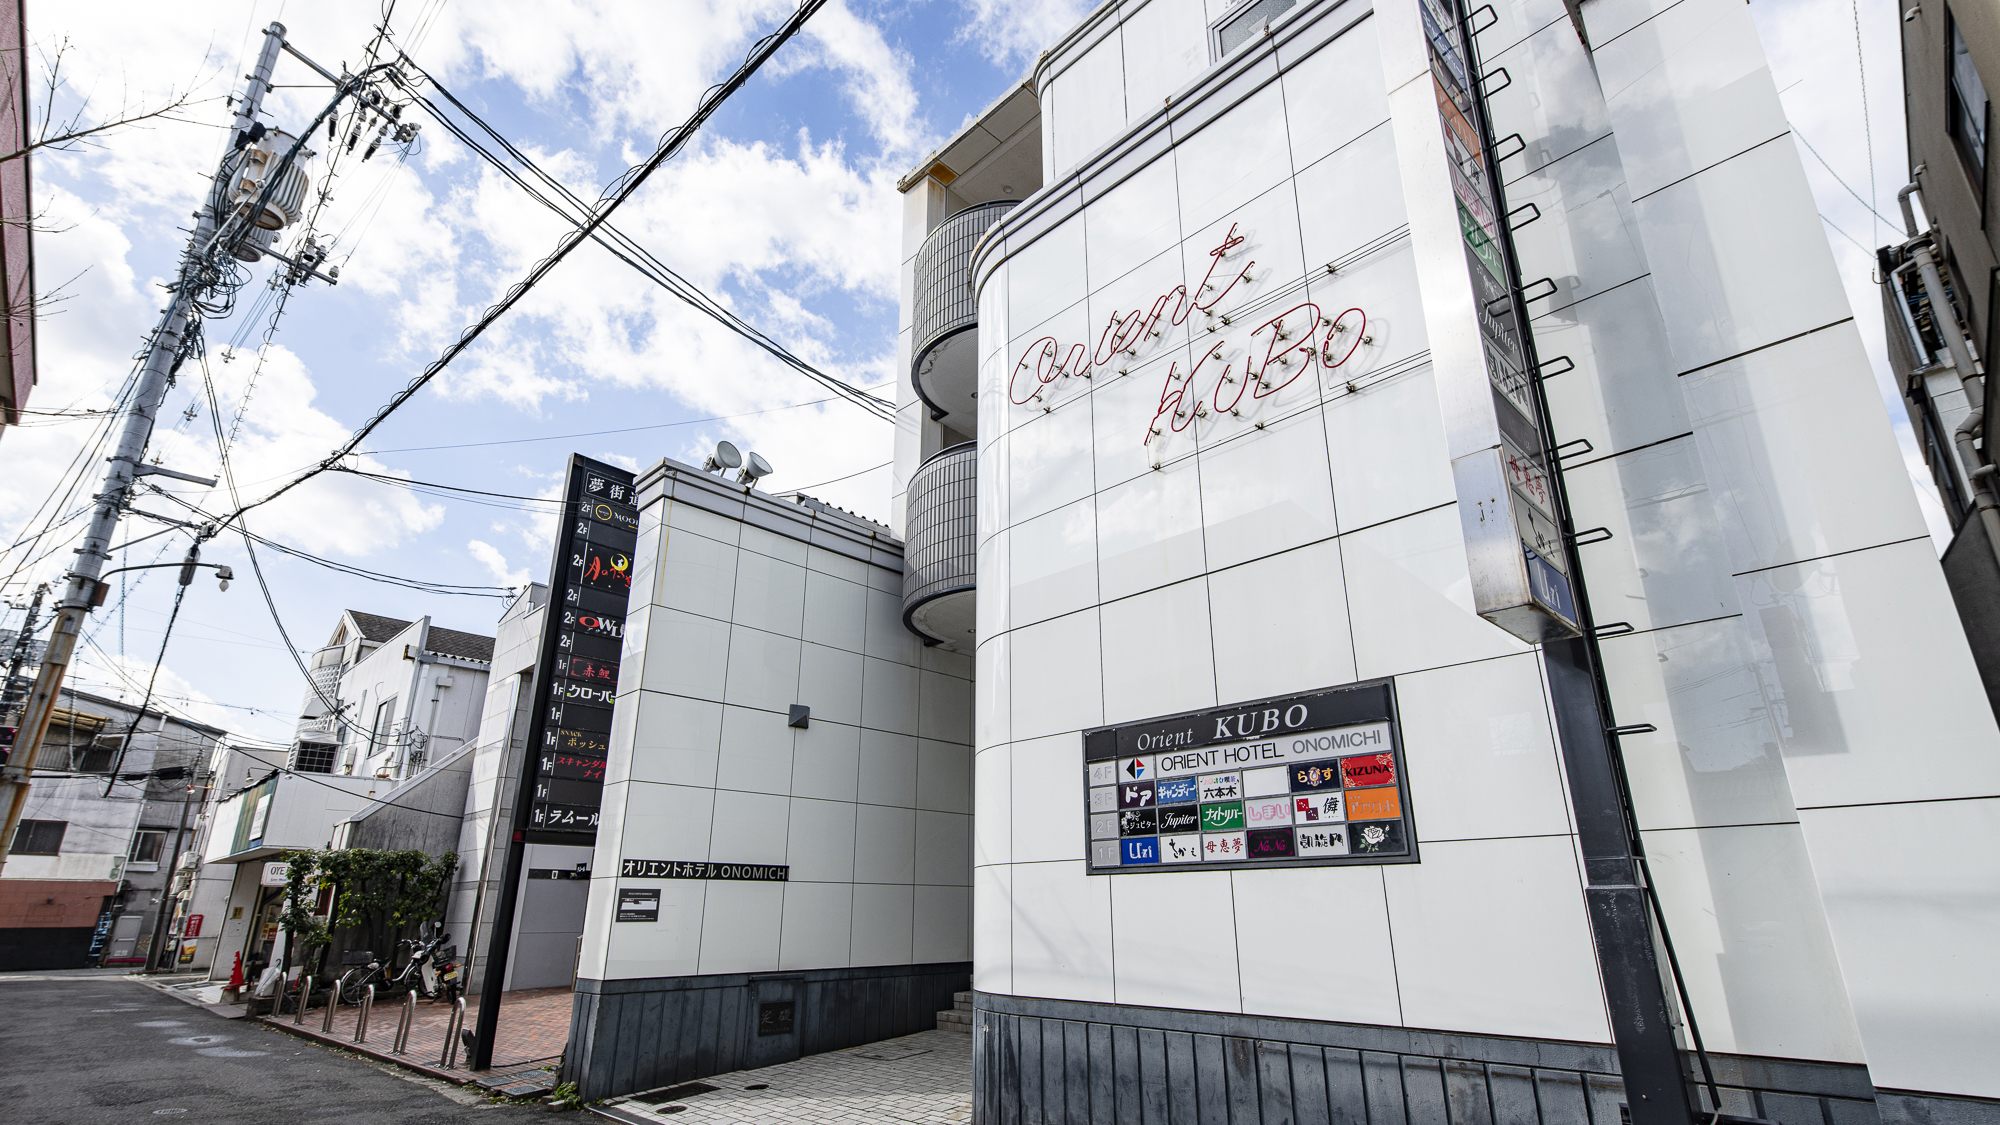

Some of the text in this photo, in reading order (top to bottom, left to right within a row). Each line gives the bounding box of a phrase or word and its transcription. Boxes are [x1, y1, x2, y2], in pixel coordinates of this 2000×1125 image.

[1479, 298, 1518, 353] Jupiter
[581, 501, 591, 513] 2F
[577, 522, 588, 535] 2F
[573, 554, 584, 567] 2F
[1536, 562, 1561, 609] Uzi
[567, 588, 578, 601] 2F
[563, 611, 575, 624] 2F
[560, 634, 571, 648] 2F
[558, 659, 567, 670] 1F
[552, 682, 564, 696] 1F
[551, 707, 561, 720] 1F
[1137, 704, 1308, 751] Orient KUBO
[546, 731, 557, 745] 1F
[1161, 729, 1382, 772] ORIENT HOTEL ONOMICHI
[541, 756, 553, 771] 1F
[1345, 764, 1391, 778] KIZUNA
[1093, 766, 1112, 780] 4F
[537, 783, 548, 798] 1F
[1125, 786, 1152, 807] ドア
[1157, 783, 1196, 799] キャンディー
[1203, 785, 1237, 800] 六本木
[1094, 791, 1113, 806] 3F
[534, 808, 544, 823] 1F
[548, 809, 599, 827] ラムール
[1203, 807, 1243, 827] ナイトリバー
[1248, 804, 1291, 821] しまい
[1095, 818, 1114, 834] 2F
[1130, 820, 1156, 830] ジュピター
[1160, 812, 1197, 829] Jupiter
[1098, 846, 1115, 860] 1F
[1129, 842, 1153, 859] Uzi
[1205, 838, 1243, 854] 母恵夢
[623, 860, 717, 878] オリエントホテル
